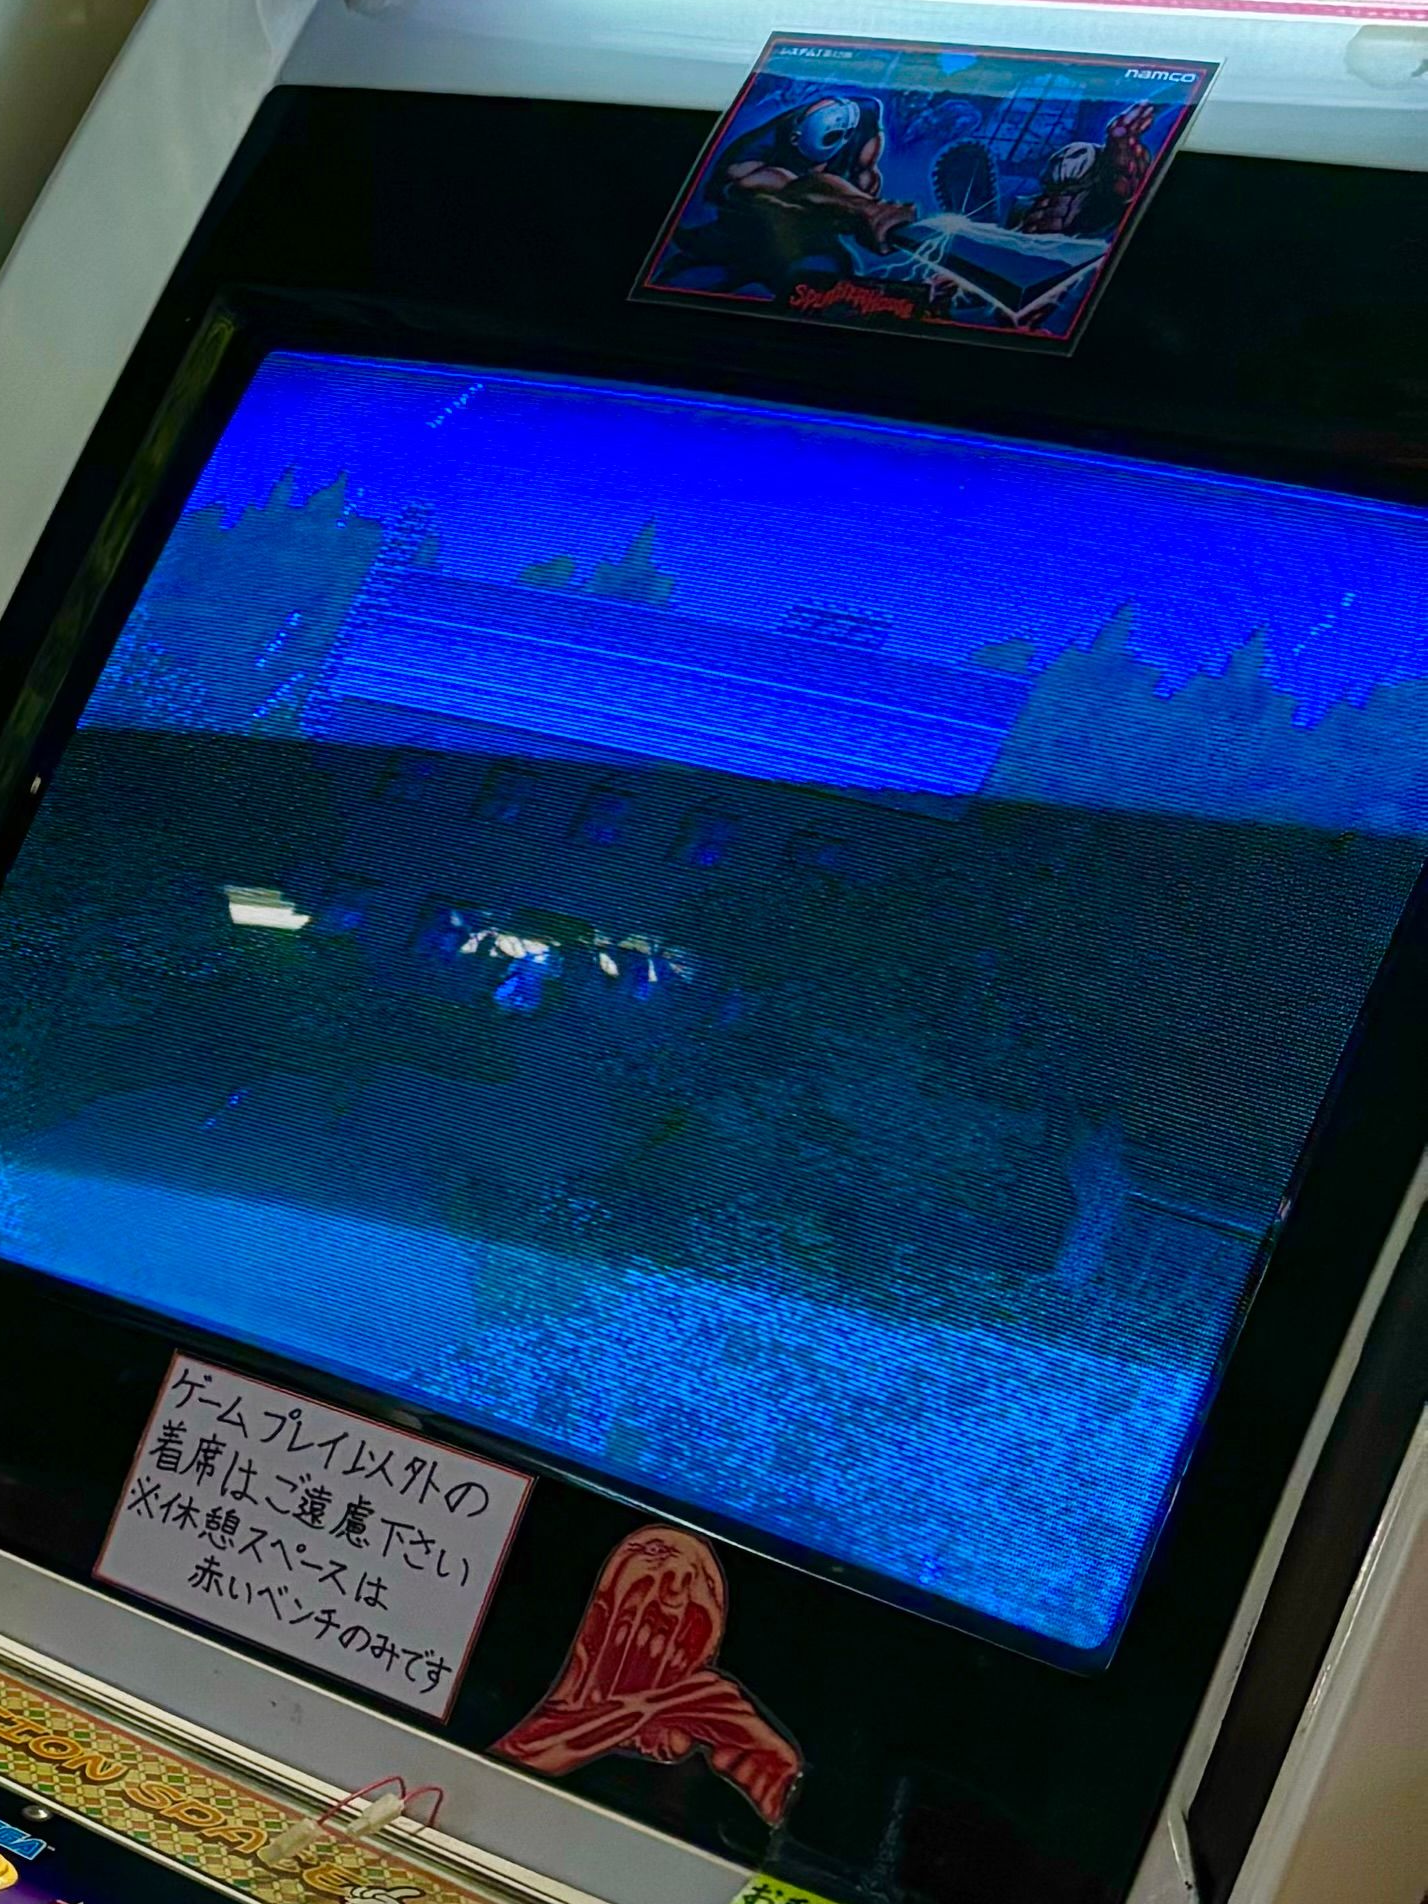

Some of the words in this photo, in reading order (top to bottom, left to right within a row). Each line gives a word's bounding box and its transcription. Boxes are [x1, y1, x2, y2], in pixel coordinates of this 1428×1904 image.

[1125, 67, 1198, 85] namco
[149, 1421, 471, 1587] 着席はご遠慮下さい
[170, 1370, 491, 1520] ゲームプレイ以外の
[125, 1474, 389, 1610] ※休憩スペースは
[187, 1558, 452, 1693] 赤いベンチのみです
